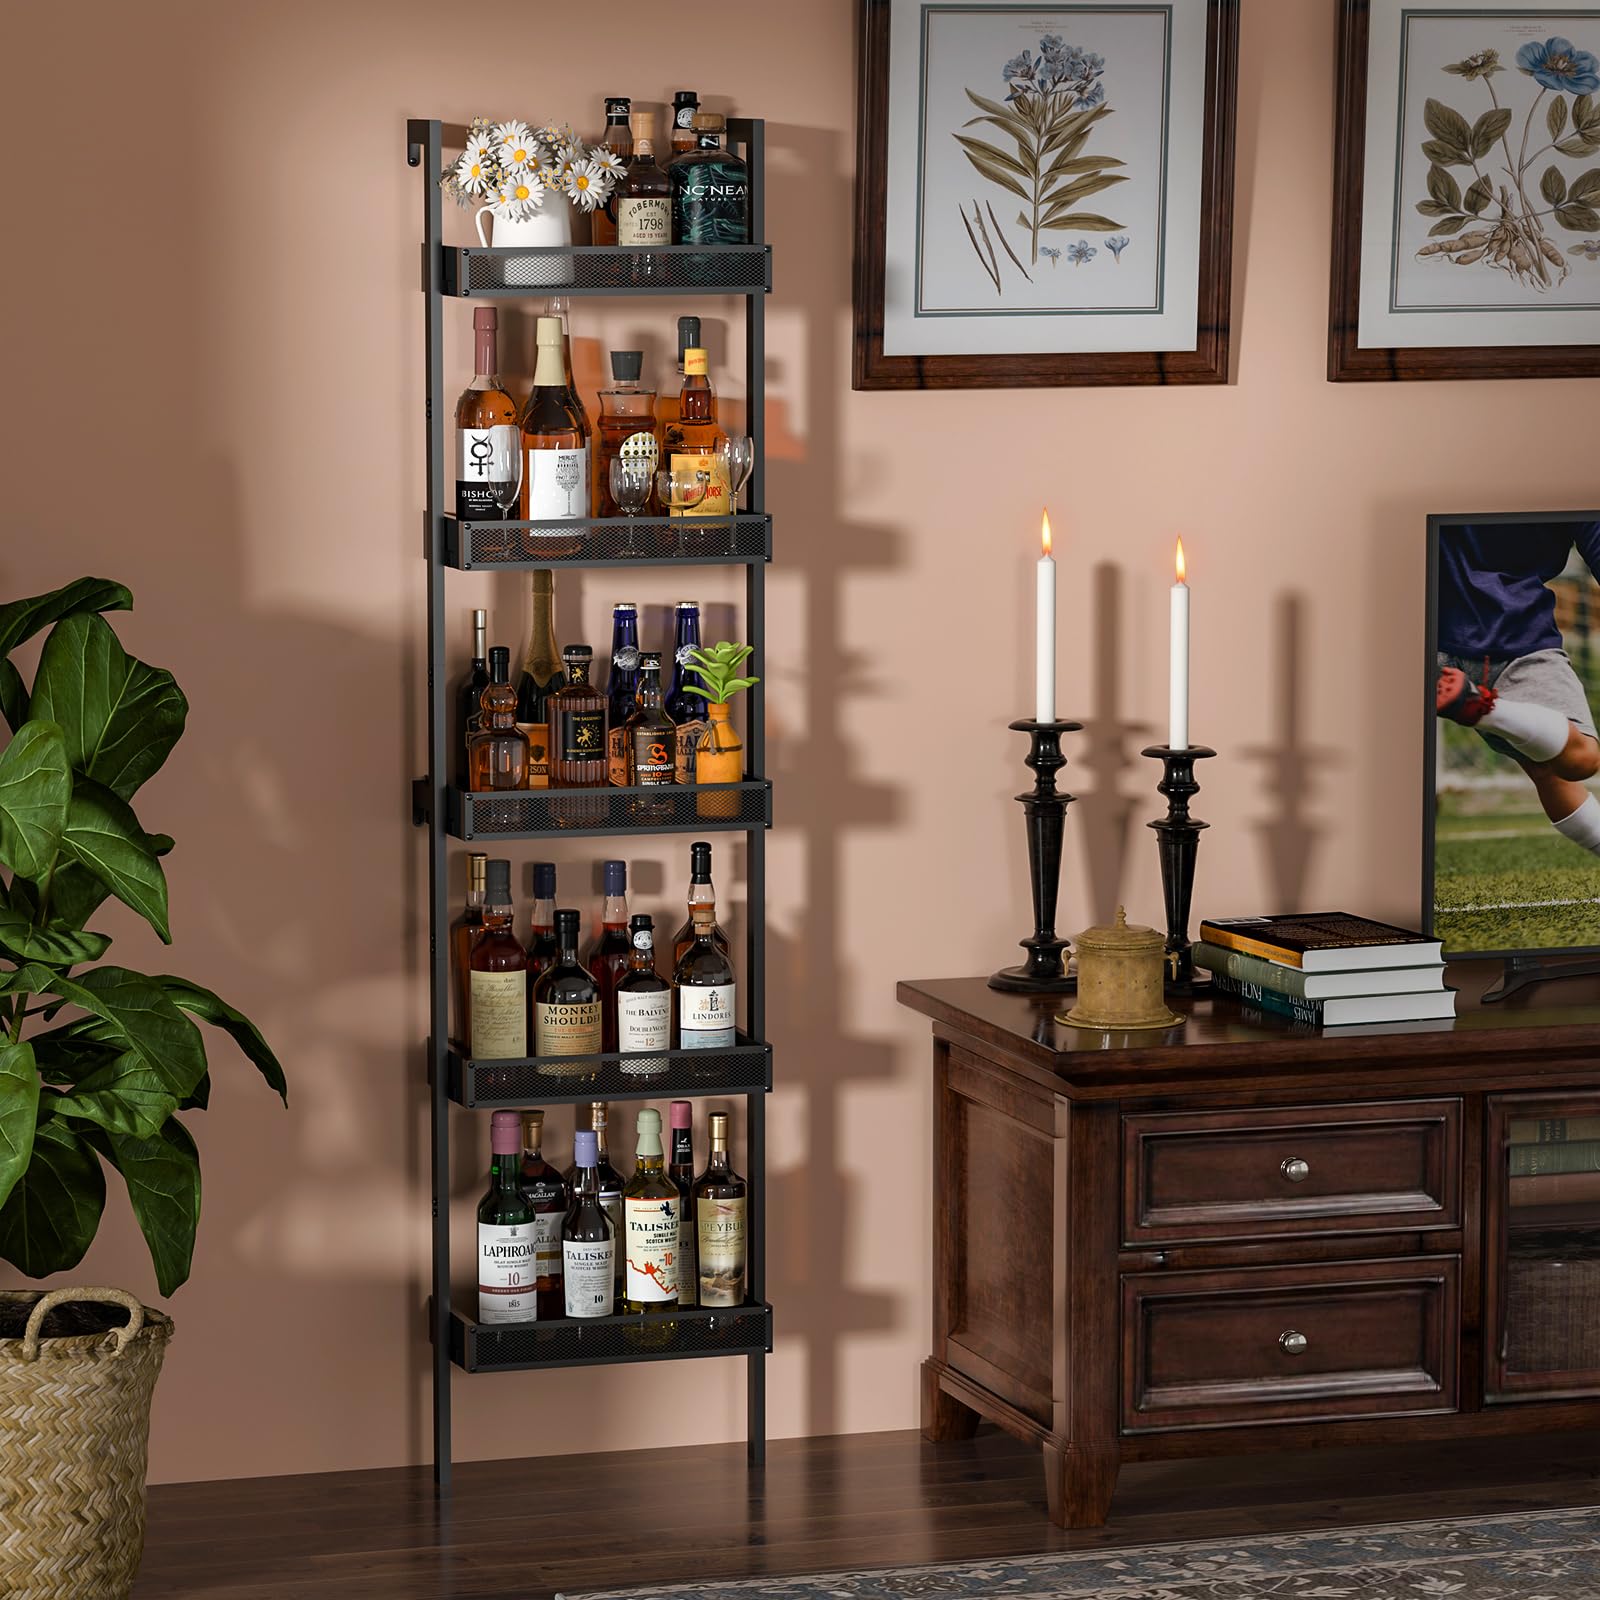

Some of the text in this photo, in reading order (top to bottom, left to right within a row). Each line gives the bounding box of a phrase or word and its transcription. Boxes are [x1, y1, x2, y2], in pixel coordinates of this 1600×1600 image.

[639, 218, 663, 230] 1798
[704, 486, 722, 500] HORSE
[548, 1004, 599, 1016] MONKEY
[1294, 1006, 1316, 1025] JAMES
[645, 1037, 655, 1047] 12
[664, 1252, 673, 1266] 10
[508, 1272, 520, 1286] 10
[508, 1300, 521, 1308] 1815
[594, 1294, 604, 1304] 10
